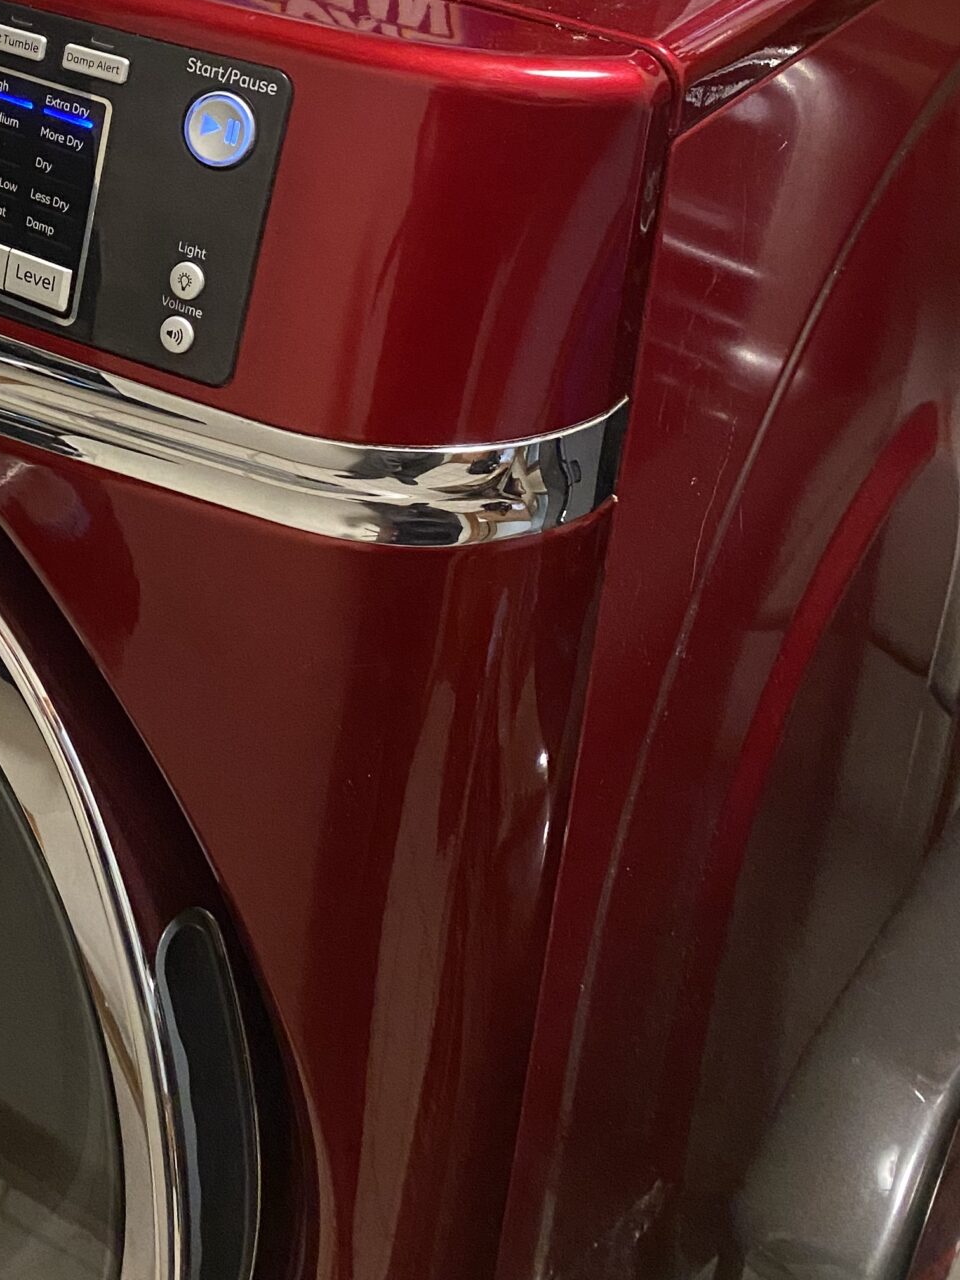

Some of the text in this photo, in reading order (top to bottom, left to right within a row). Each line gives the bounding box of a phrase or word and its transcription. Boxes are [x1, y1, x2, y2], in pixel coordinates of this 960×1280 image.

[3, 34, 40, 54] Tumble
[66, 51, 120, 76] Damp Alert
[186, 56, 279, 96] Start/Pause
[45, 94, 90, 119] Extra Dry
[40, 125, 84, 152] More Dry
[35, 157, 53, 174] Dry
[0, 177, 18, 193] Low
[30, 187, 70, 213] Less Dry
[26, 215, 55, 236] Damp
[178, 240, 208, 261] Light
[15, 263, 56, 293] Level
[161, 294, 203, 320] Volume
